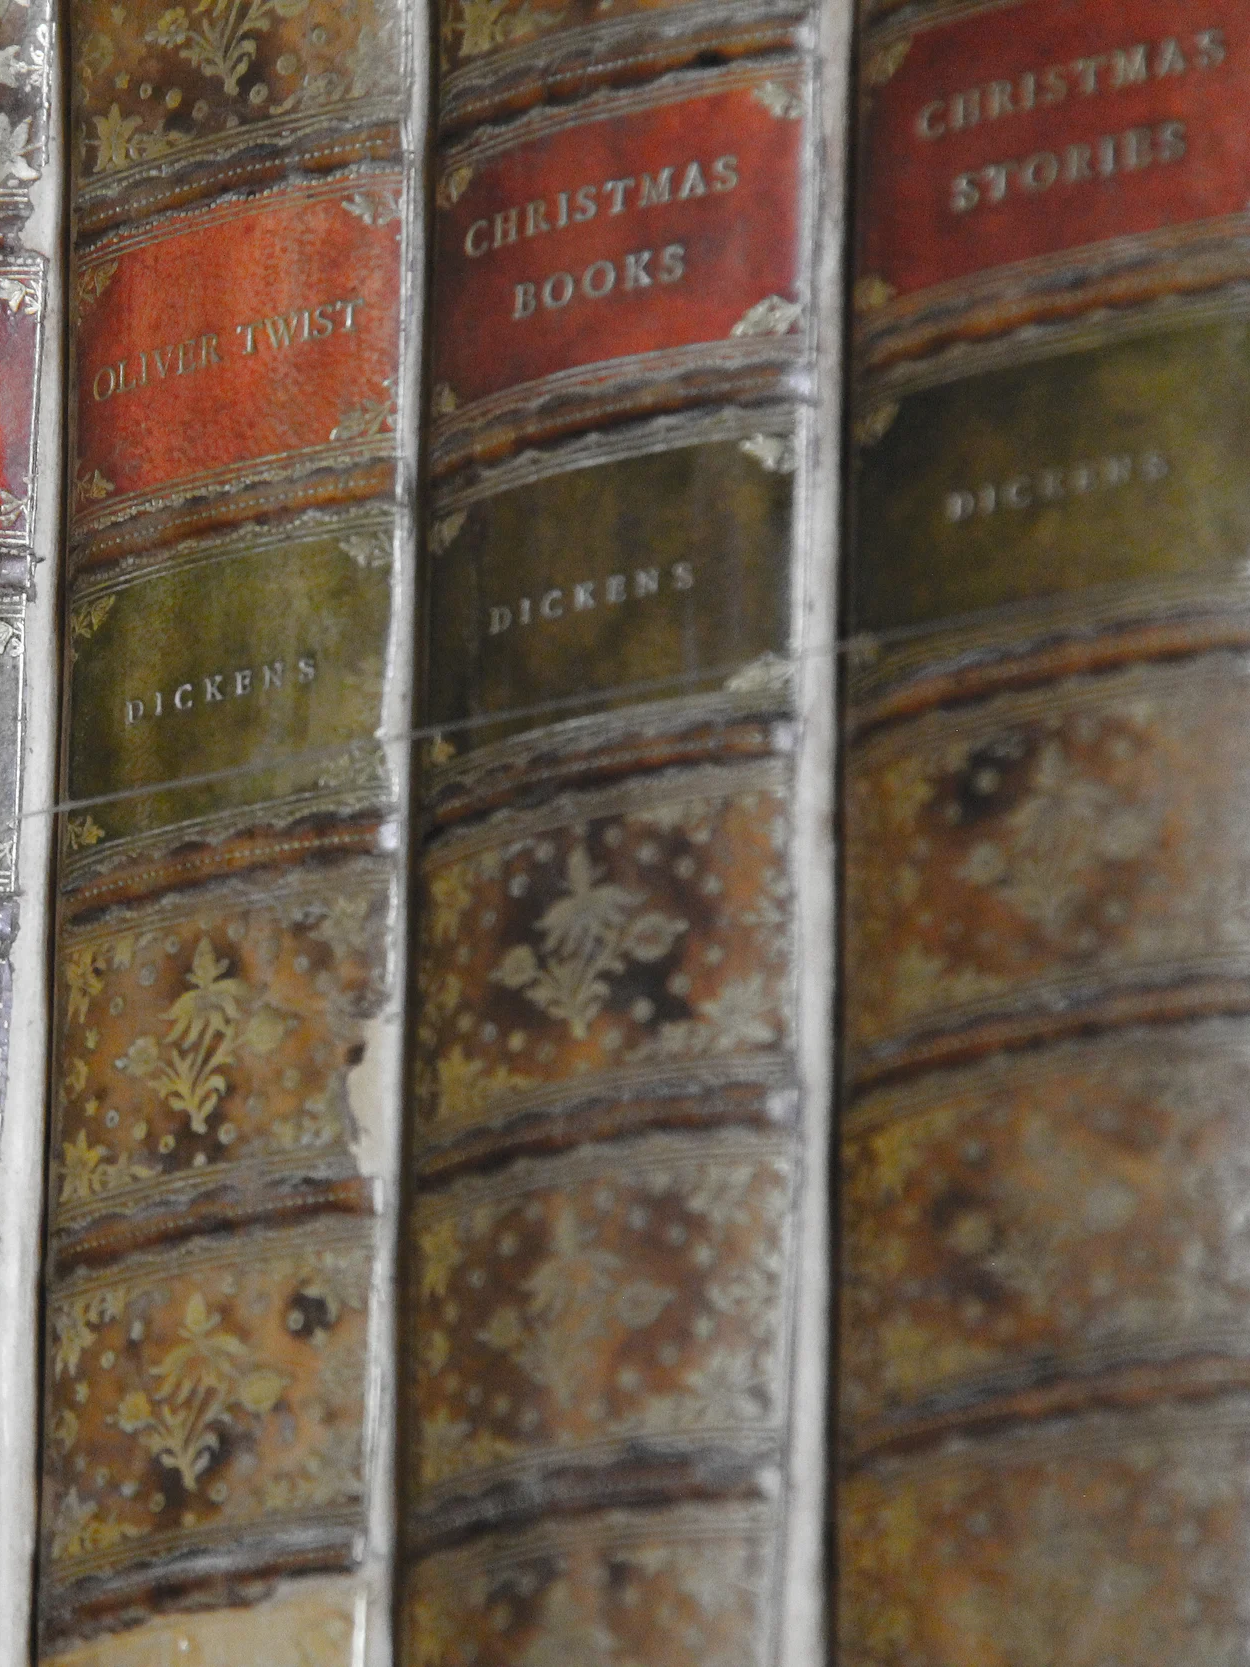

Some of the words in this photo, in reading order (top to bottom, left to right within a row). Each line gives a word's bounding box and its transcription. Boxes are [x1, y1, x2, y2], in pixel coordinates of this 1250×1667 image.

[916, 28, 1227, 140] CHRISTMAS
[464, 155, 740, 259] CHRISTMAS
[953, 120, 1186, 213] STORIES
[512, 244, 686, 321] BOOKS
[92, 333, 222, 402] OLIVER
[235, 297, 365, 357] TWIST
[948, 451, 1170, 523] DICKENS
[489, 561, 694, 635] DICKENS
[125, 656, 317, 724] DICKENS
